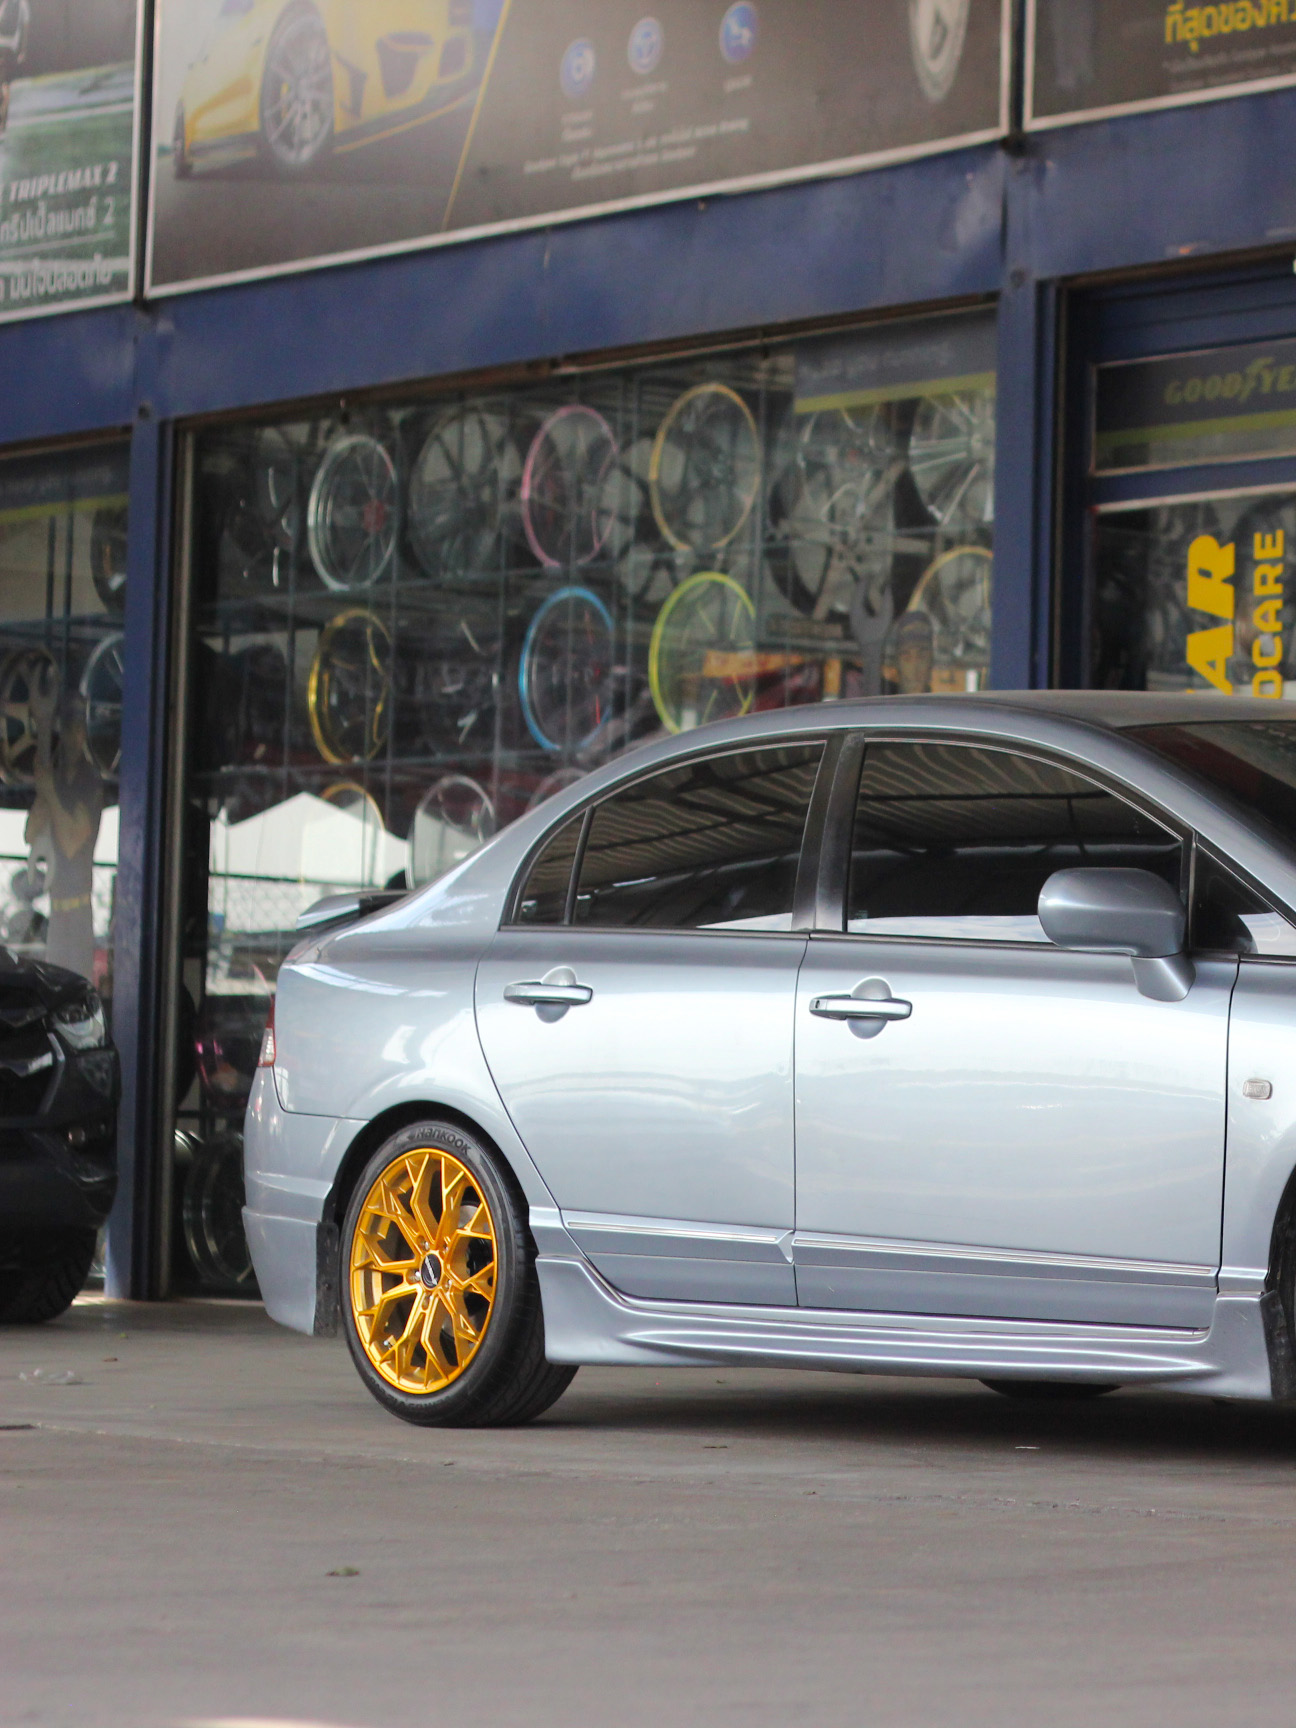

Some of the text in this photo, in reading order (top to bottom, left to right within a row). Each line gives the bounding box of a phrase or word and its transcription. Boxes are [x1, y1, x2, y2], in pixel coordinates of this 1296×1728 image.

[105, 161, 118, 184] 2
[103, 197, 115, 224] 2
[1187, 534, 1235, 696] AR
[416, 1126, 472, 1156] Hankook
